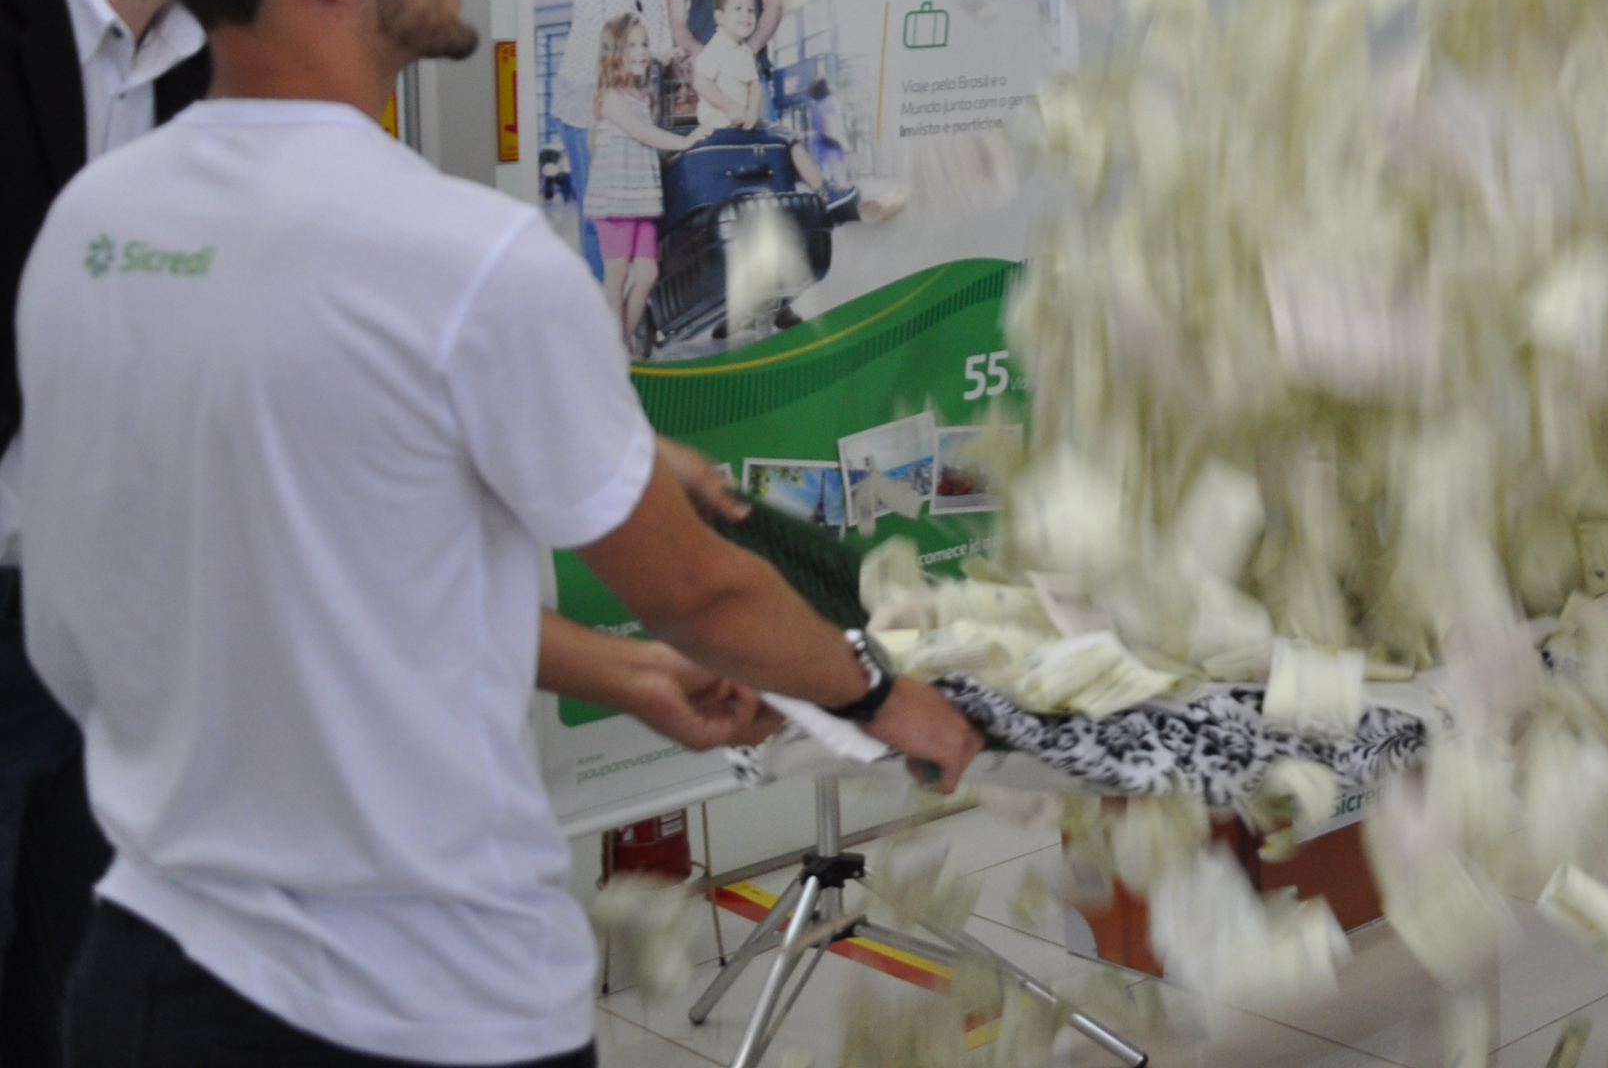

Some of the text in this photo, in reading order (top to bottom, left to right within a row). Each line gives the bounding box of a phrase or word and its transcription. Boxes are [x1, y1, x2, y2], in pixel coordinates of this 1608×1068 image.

[931, 77, 956, 93] pelo
[958, 74, 990, 90] Brasil
[900, 101, 941, 115] Mundo
[942, 98, 972, 114] junto
[974, 97, 998, 110] com
[943, 122, 950, 133] e
[963, 350, 1009, 401] 55
